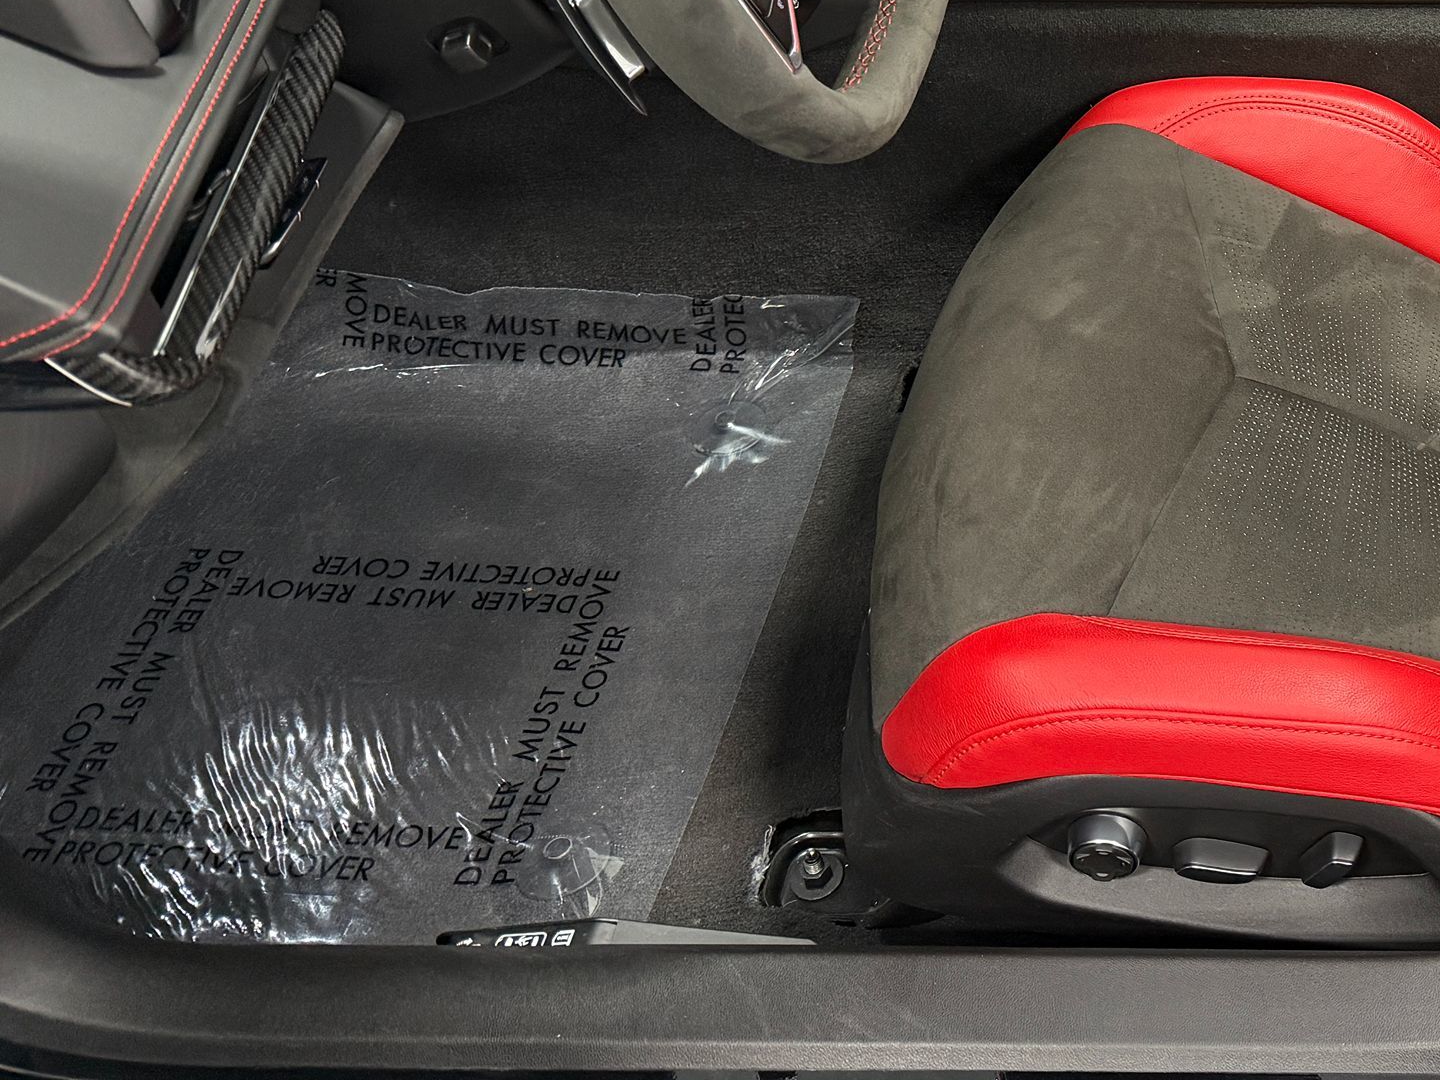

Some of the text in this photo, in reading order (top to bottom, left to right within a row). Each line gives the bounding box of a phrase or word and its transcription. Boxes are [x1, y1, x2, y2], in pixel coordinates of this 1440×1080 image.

[374, 304, 687, 344] DEALER MUST REMOVE
[372, 332, 626, 368] PROTECTIVE COVER
[312, 556, 590, 587] PROTECTIVE COVER
[227, 577, 579, 613] DEALER MUST REMOVE
[25, 548, 211, 791] PROTECTIVE COVER
[23, 550, 244, 862] DEALER MUST REMOVE
[453, 570, 620, 885] DEALER MUST REMOVE
[491, 626, 630, 885] PROTECTIVE COVER
[75, 805, 194, 834] DEALER
